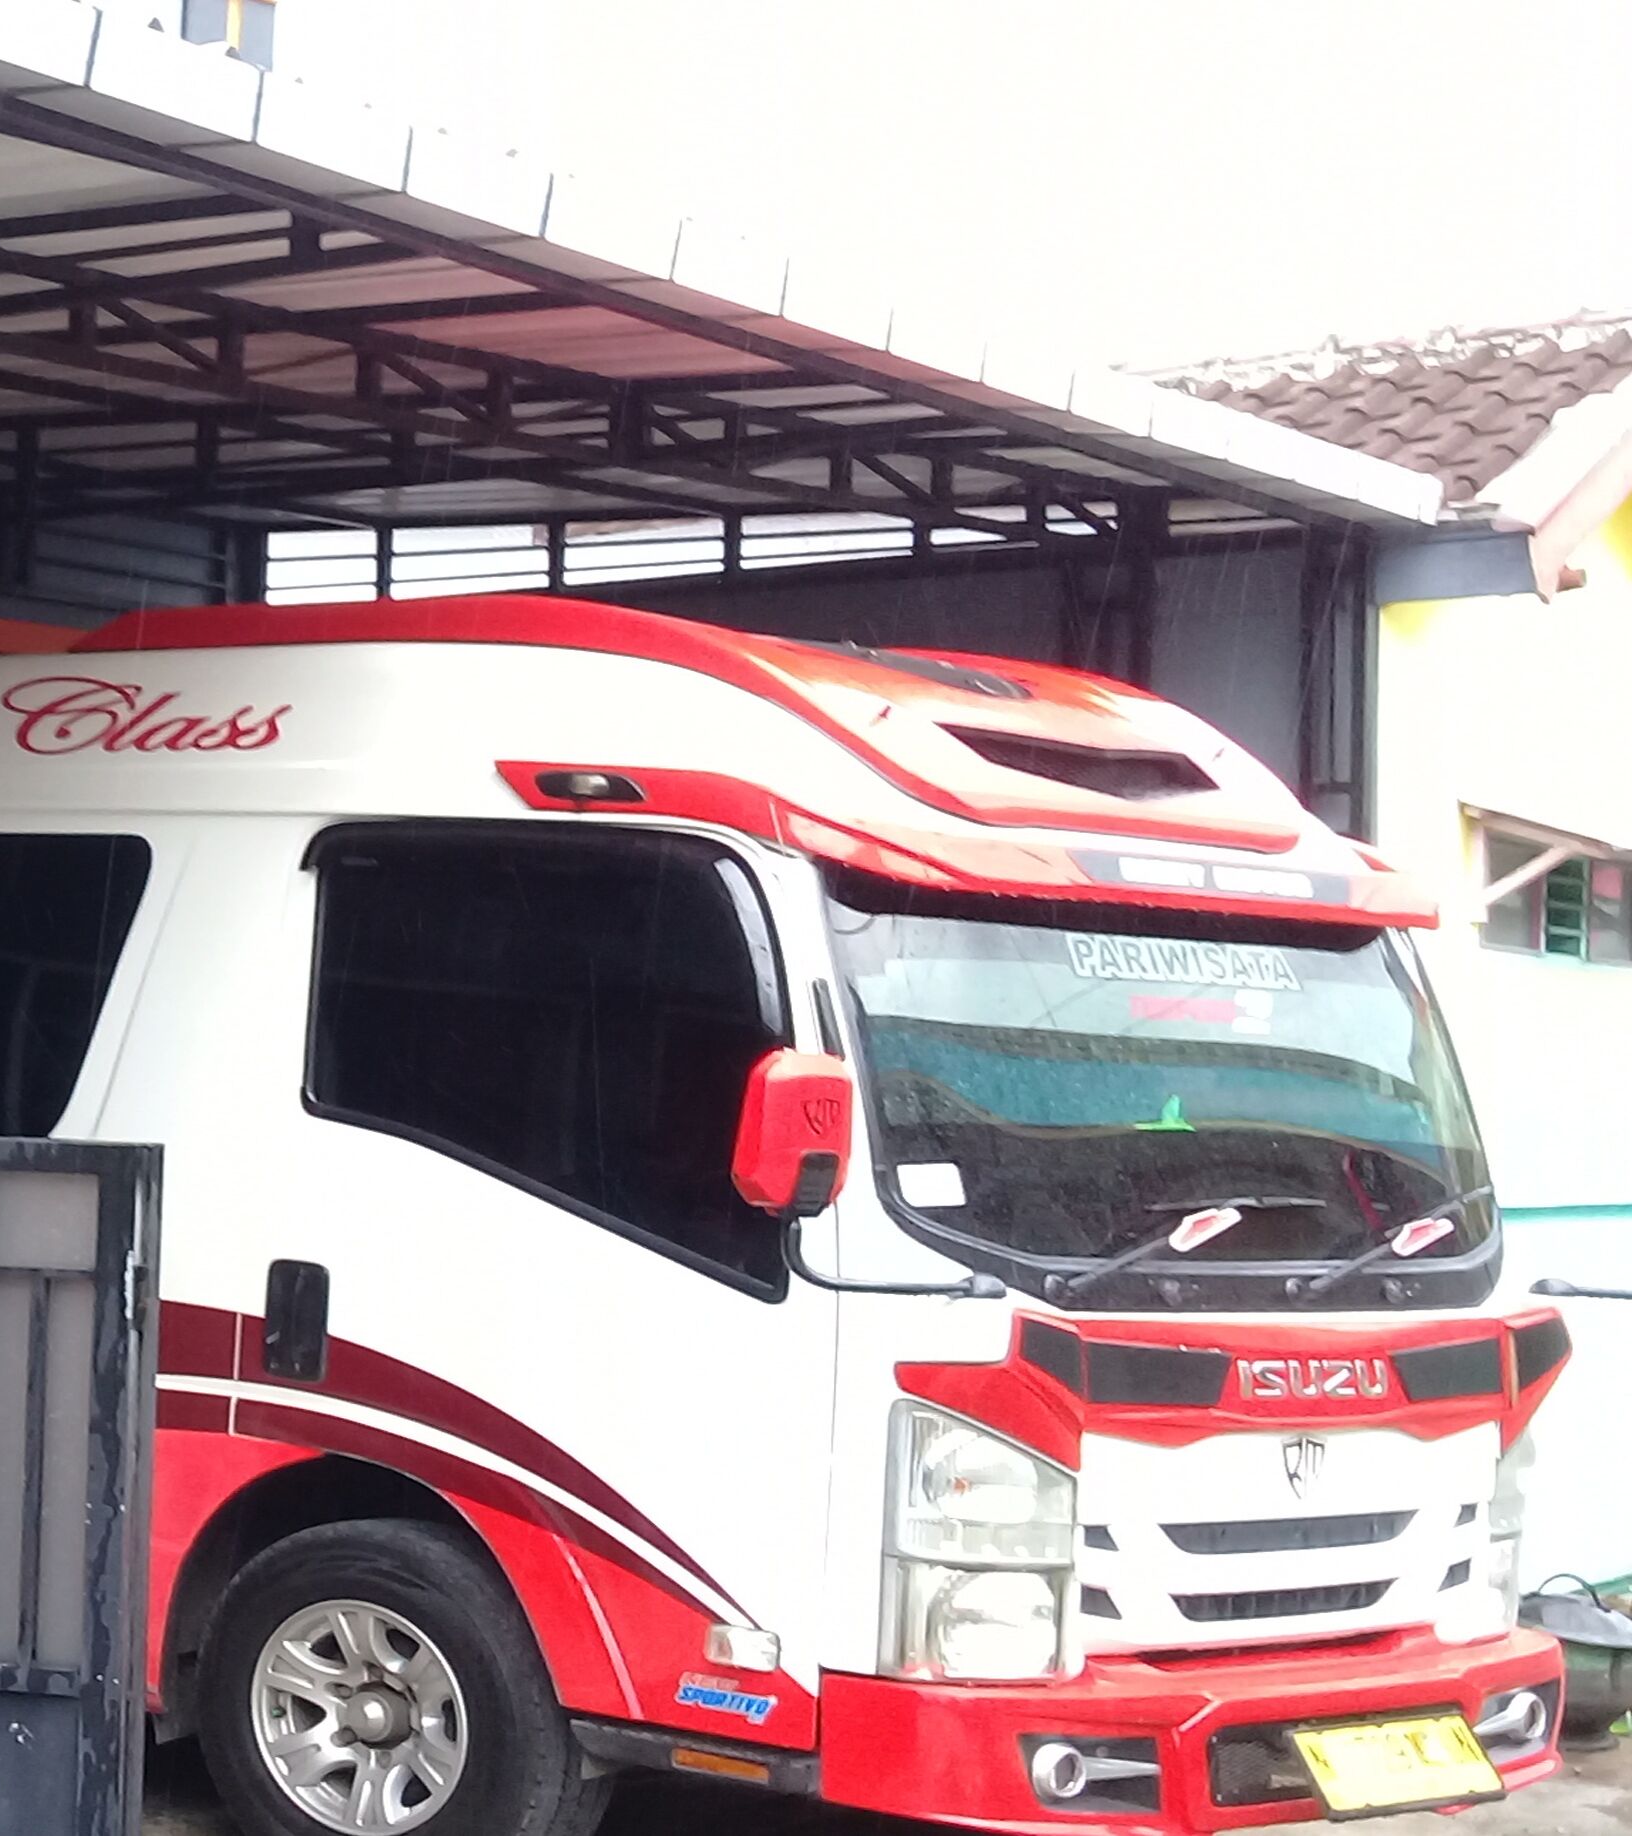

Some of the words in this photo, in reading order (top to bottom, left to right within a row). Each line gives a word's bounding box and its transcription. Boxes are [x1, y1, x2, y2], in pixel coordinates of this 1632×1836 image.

[2, 676, 294, 756] Class
[1072, 938, 1294, 985] PARIWISATA
[1236, 1359, 1389, 1399] ISUZU
